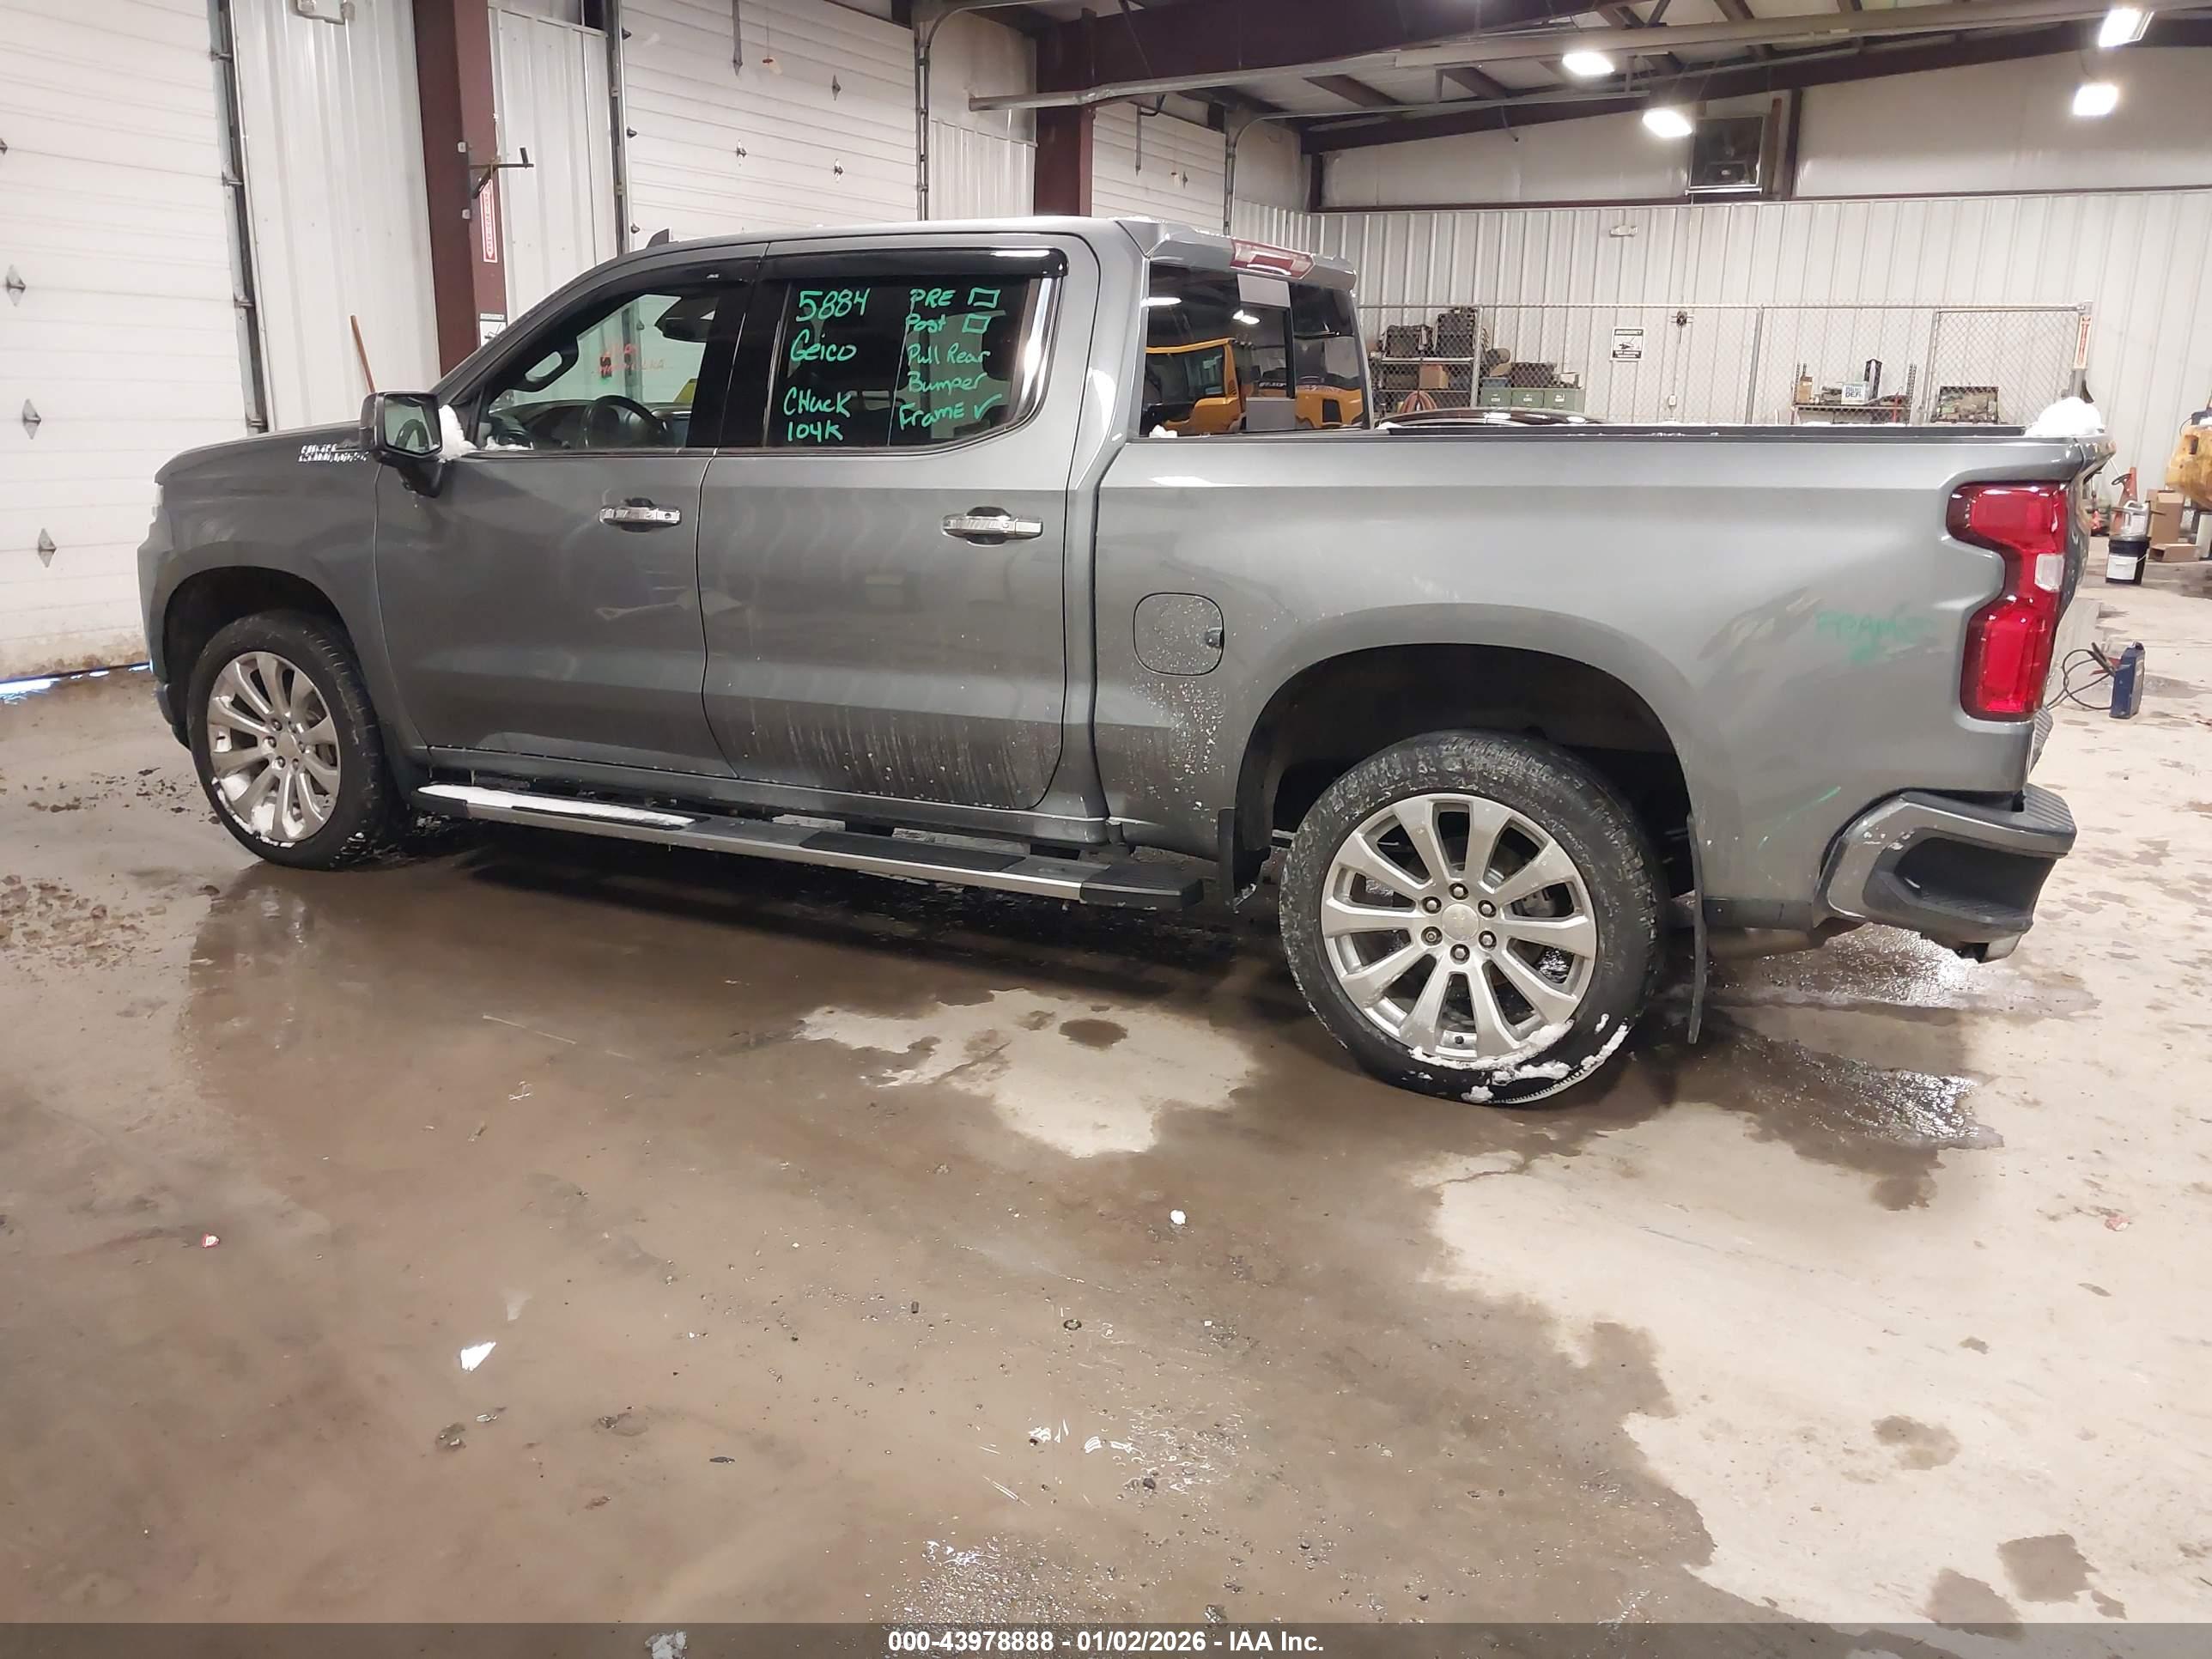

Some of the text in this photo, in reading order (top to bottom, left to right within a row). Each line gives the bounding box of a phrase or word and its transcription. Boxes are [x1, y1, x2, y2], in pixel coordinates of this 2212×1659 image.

[795, 288, 872, 322] 5884
[909, 288, 957, 310] PRE
[790, 328, 858, 362] Geico
[907, 342, 991, 367] Pull Rear
[907, 370, 988, 396] Bumper
